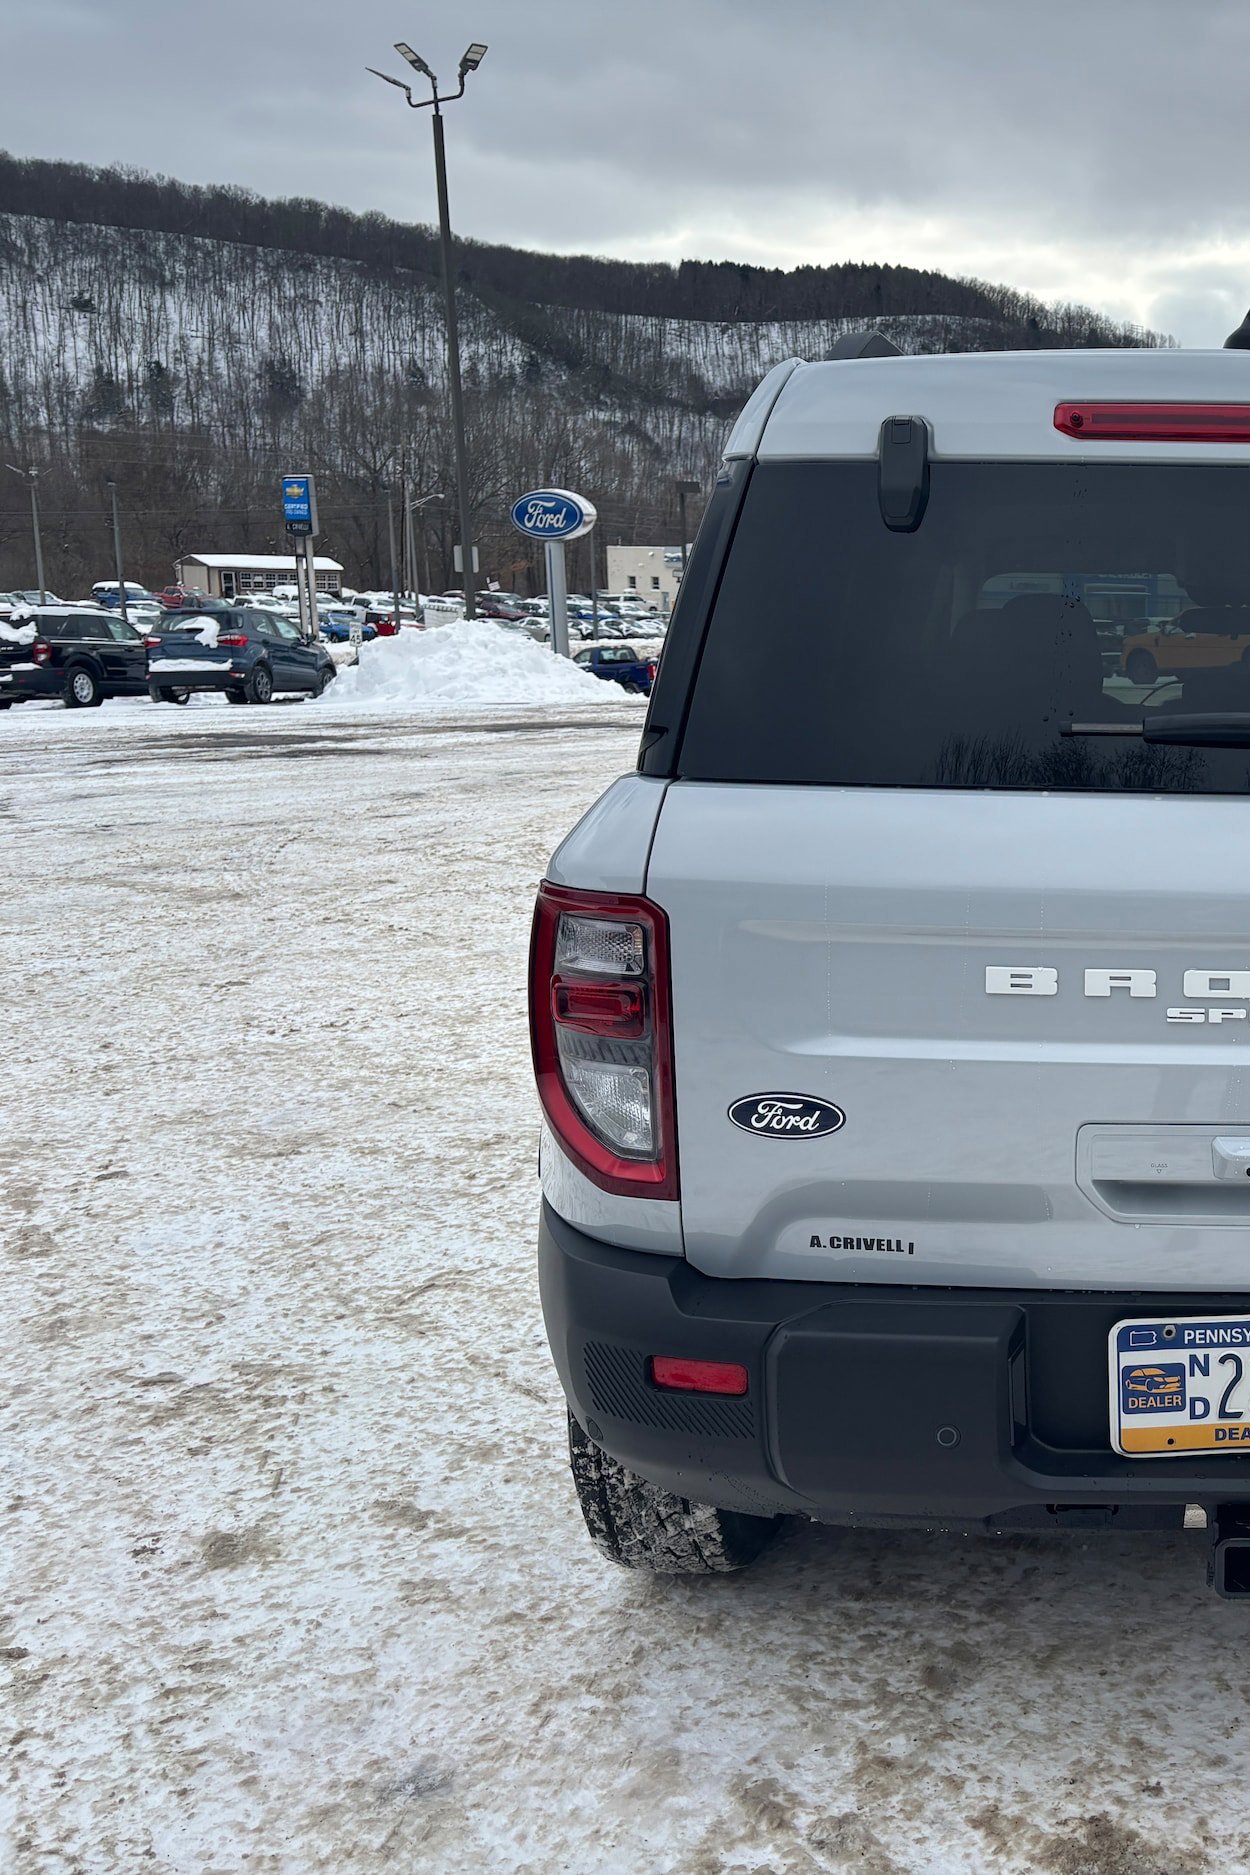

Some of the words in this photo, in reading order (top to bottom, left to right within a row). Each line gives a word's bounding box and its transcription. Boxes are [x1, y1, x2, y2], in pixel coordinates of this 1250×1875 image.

[524, 500, 567, 528] Ford
[350, 634, 361, 645] 45
[750, 1101, 821, 1131] Ford
[1128, 1395, 1182, 1409] DEALER
